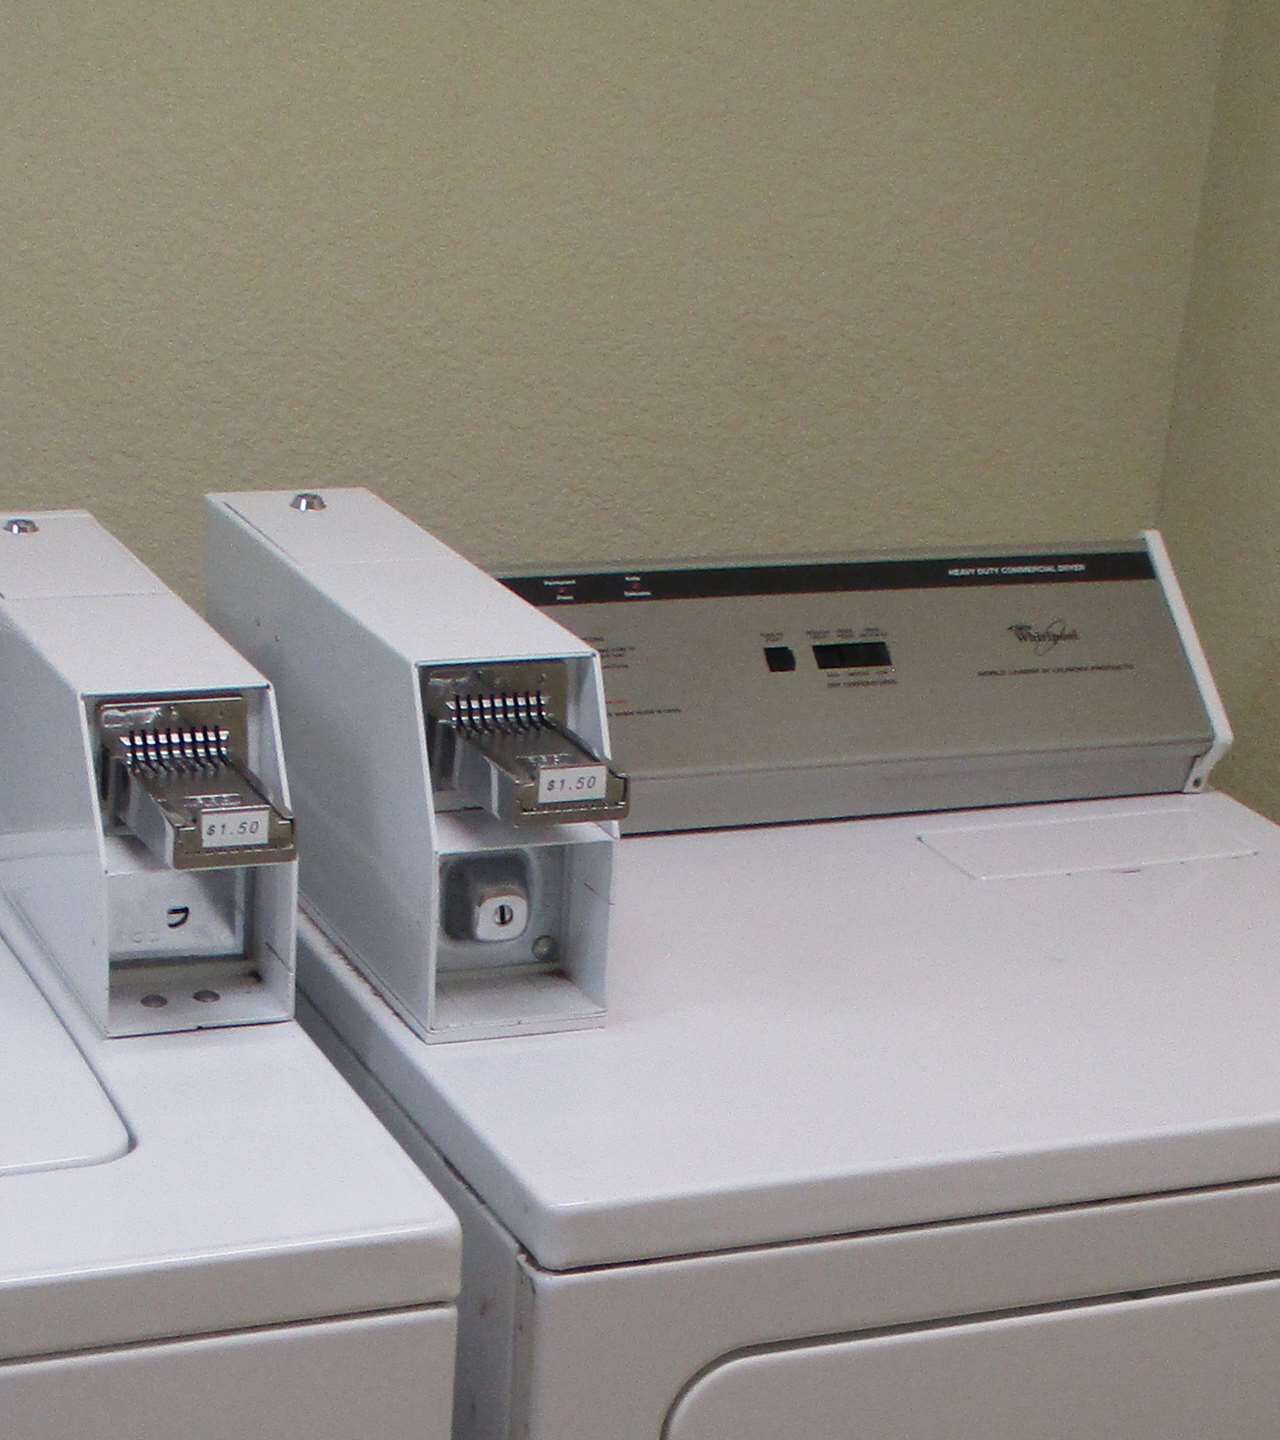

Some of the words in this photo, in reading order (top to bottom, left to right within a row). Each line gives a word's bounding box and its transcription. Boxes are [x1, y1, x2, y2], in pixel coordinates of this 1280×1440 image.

[977, 567, 999, 575] DUTY
[546, 775, 597, 792] $1.50
[206, 820, 260, 837] $1.50
